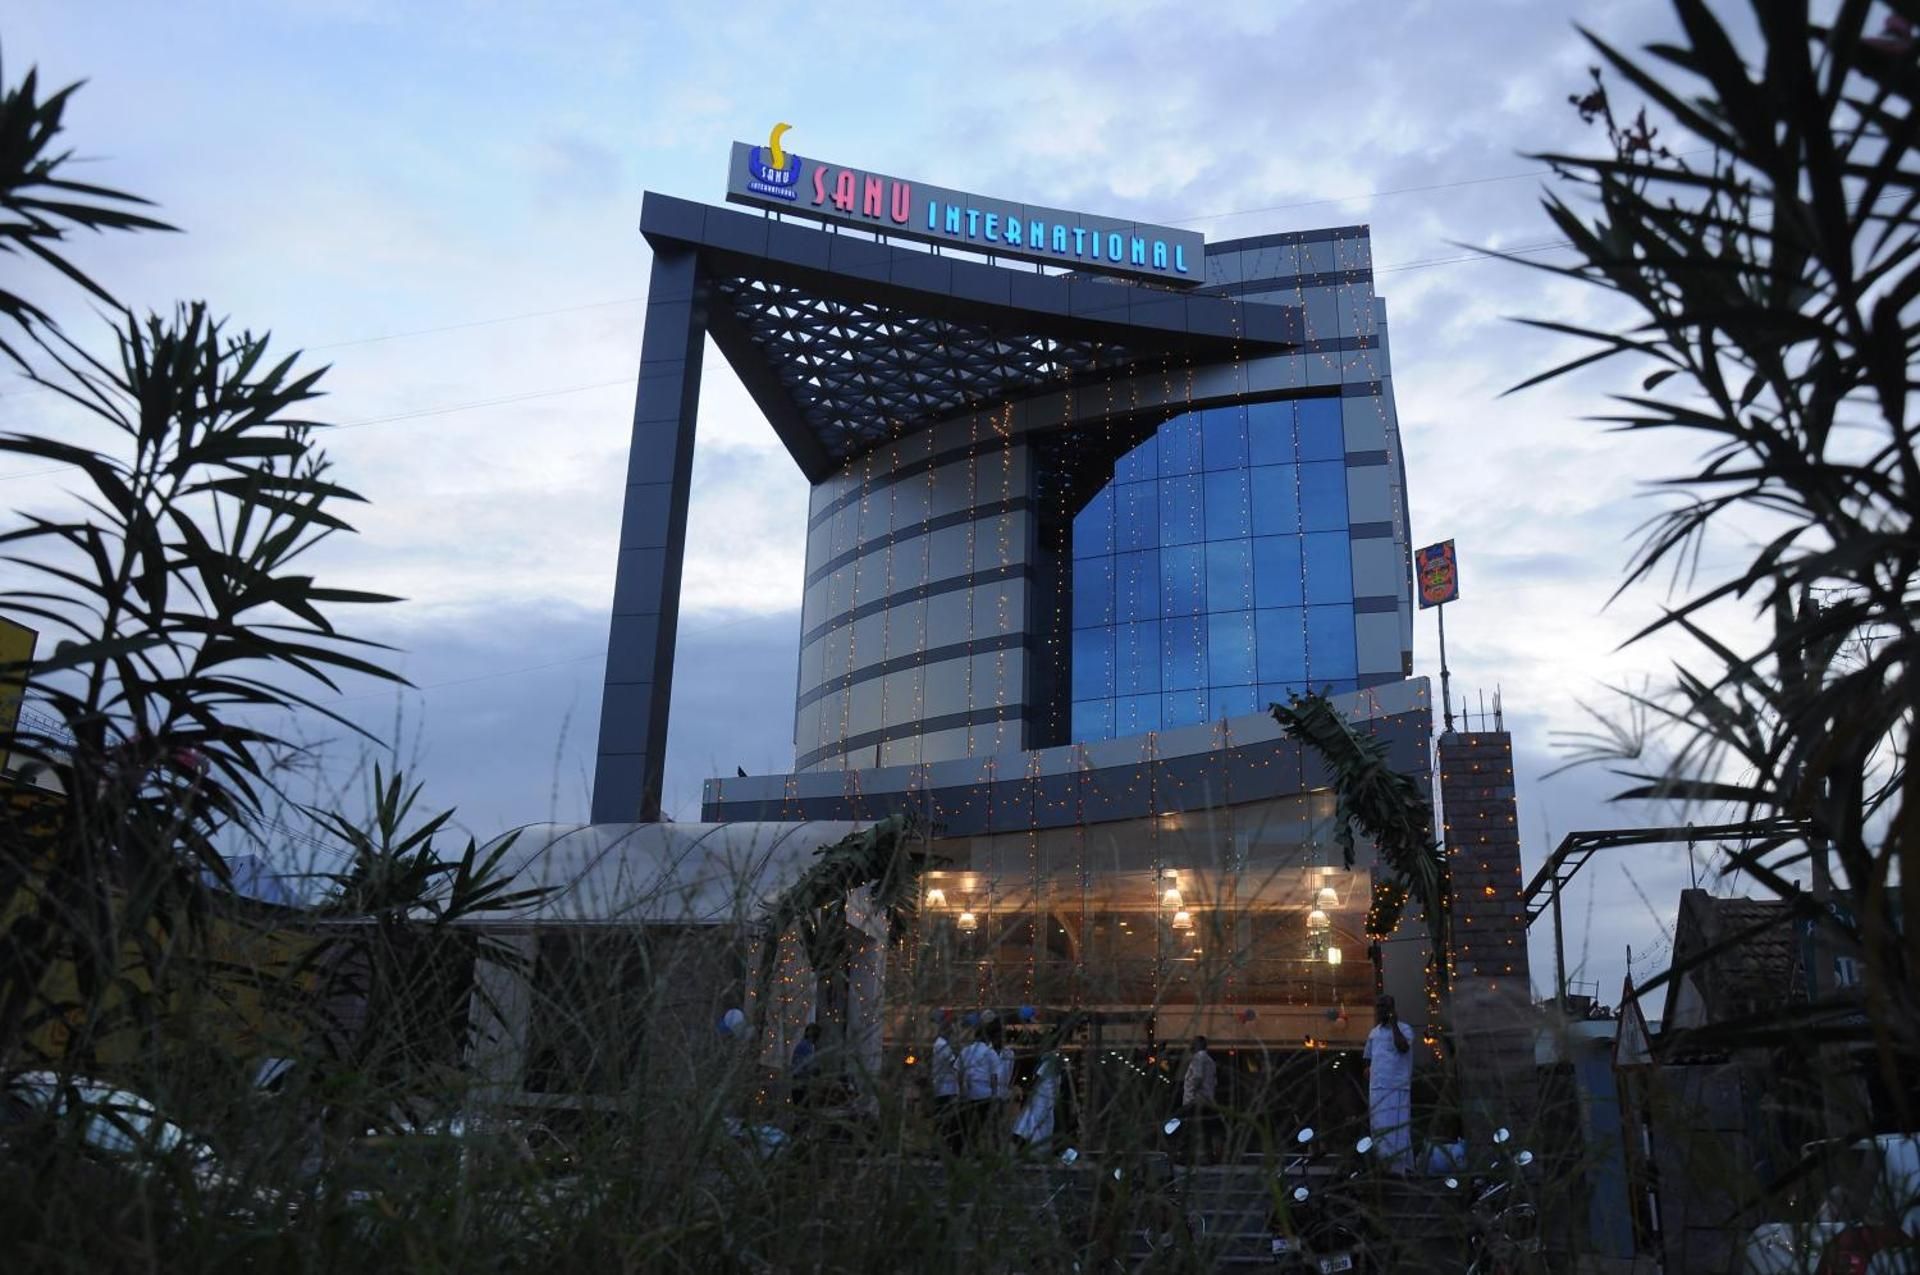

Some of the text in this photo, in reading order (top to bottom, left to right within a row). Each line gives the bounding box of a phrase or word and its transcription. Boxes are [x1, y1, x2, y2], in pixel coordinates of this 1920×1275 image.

[761, 166, 790, 184] SANU
[812, 165, 1188, 273] SANU INTERNATIONAL
